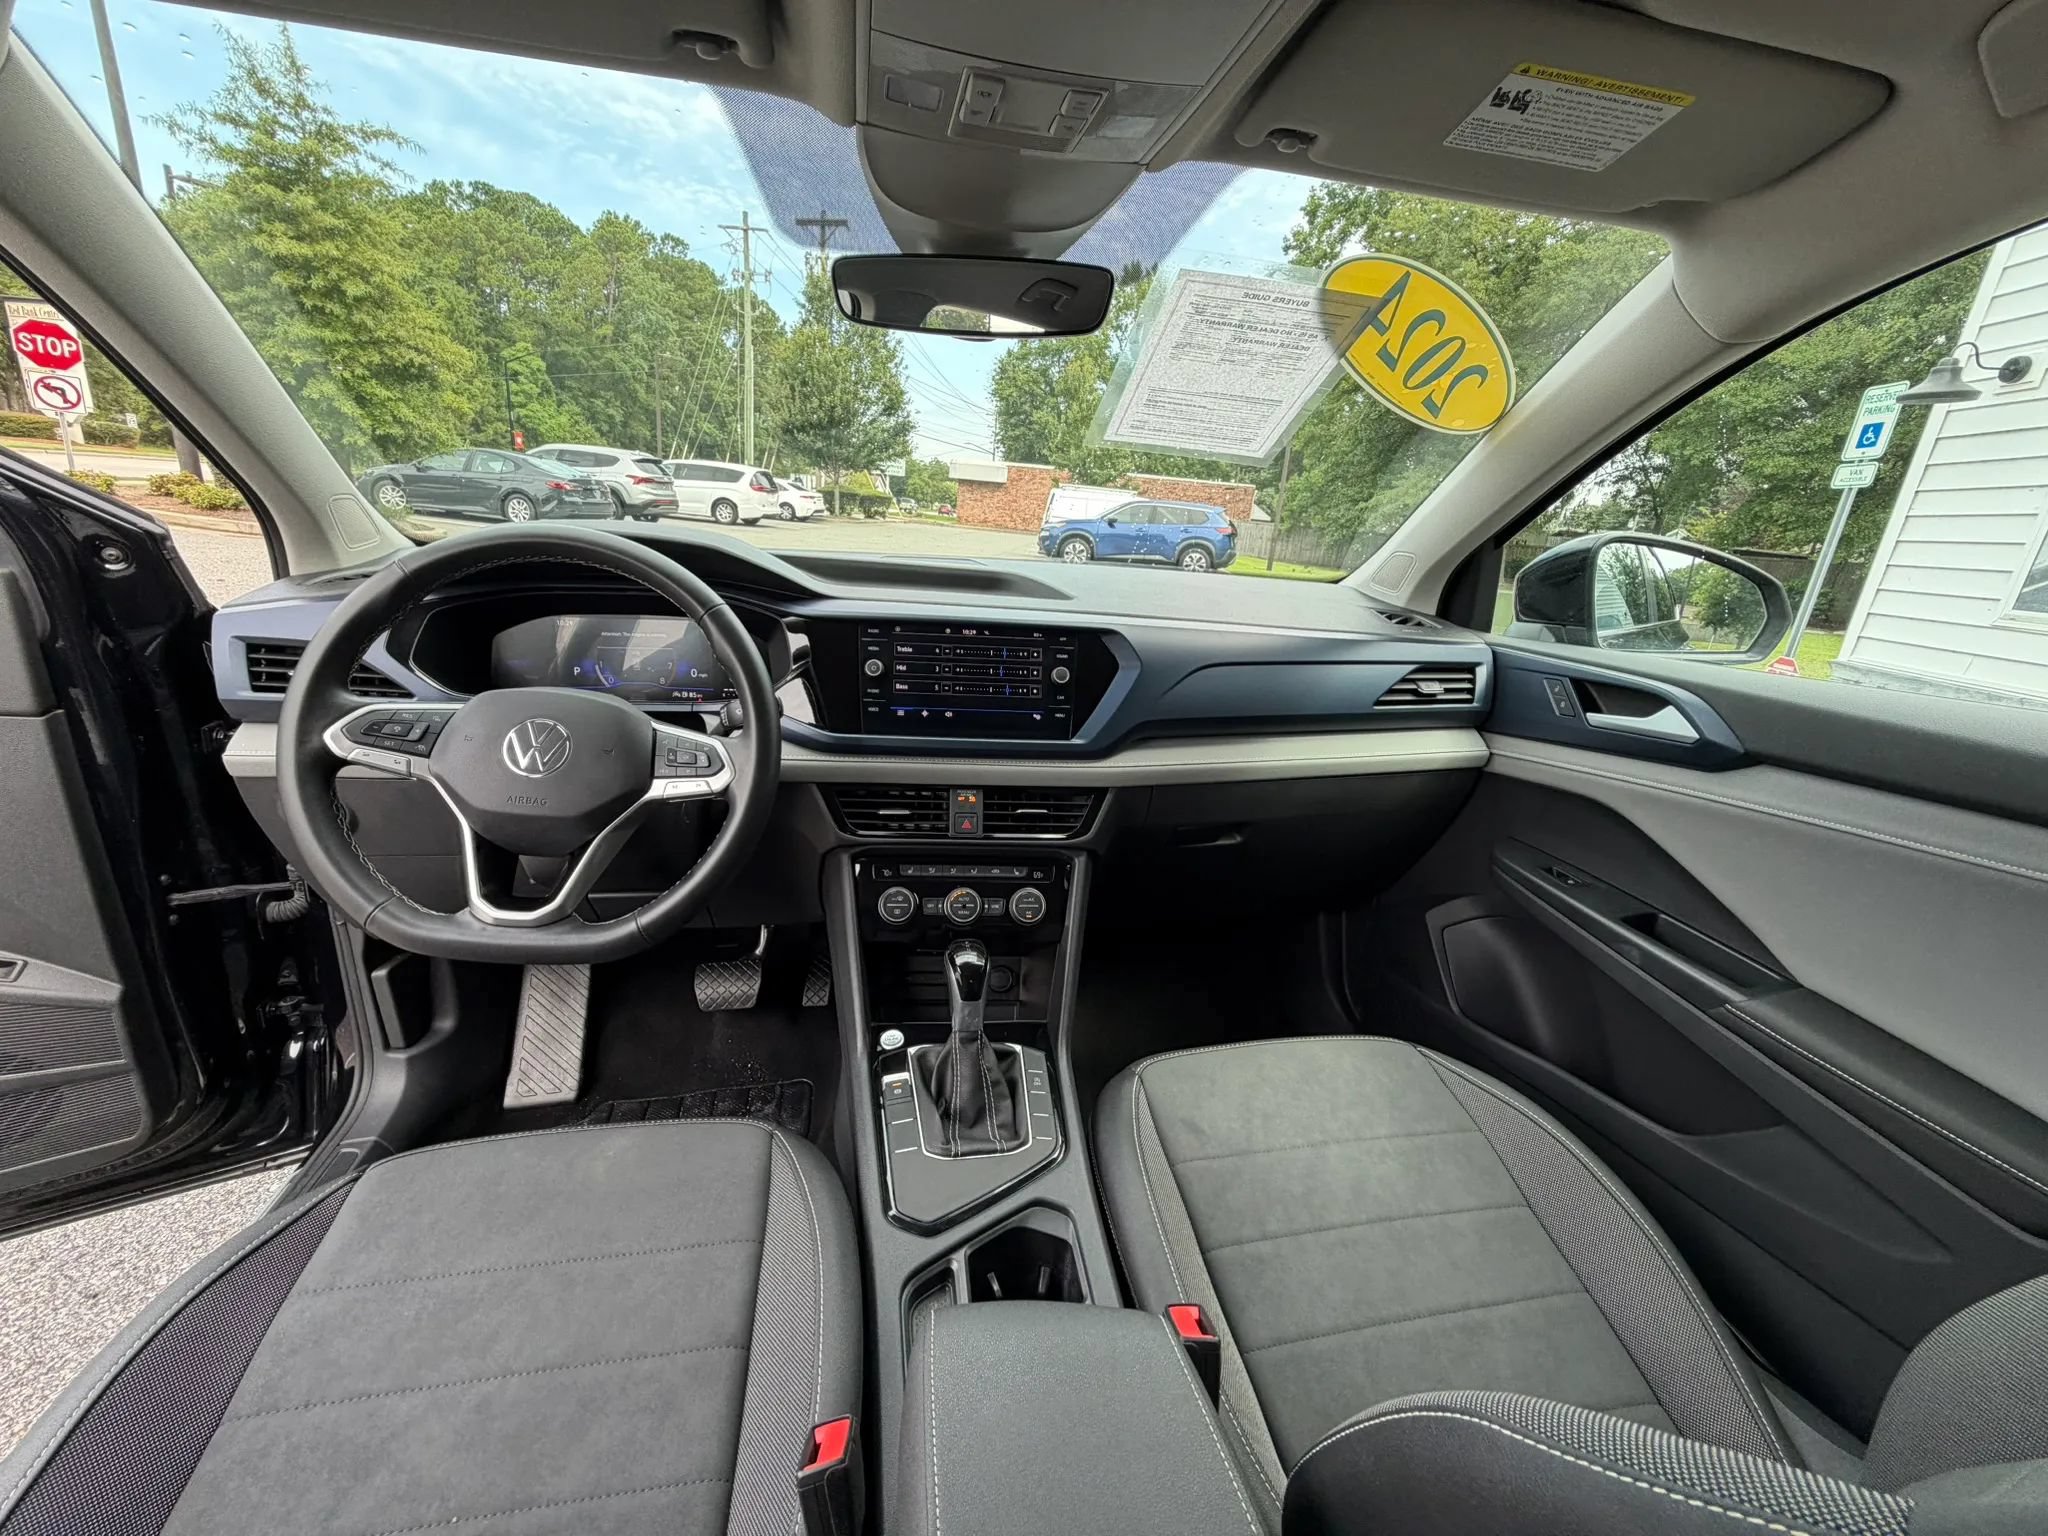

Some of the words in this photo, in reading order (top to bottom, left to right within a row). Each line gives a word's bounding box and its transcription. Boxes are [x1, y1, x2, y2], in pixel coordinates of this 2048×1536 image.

[1536, 69, 1593, 87] WARNING!
[17, 332, 77, 358] STOP
[1865, 390, 1904, 404] RESERV
[1863, 404, 1896, 416] PARKING
[573, 667, 581, 676] P
[690, 668, 698, 678] 0
[506, 795, 548, 806] AIRBAG
